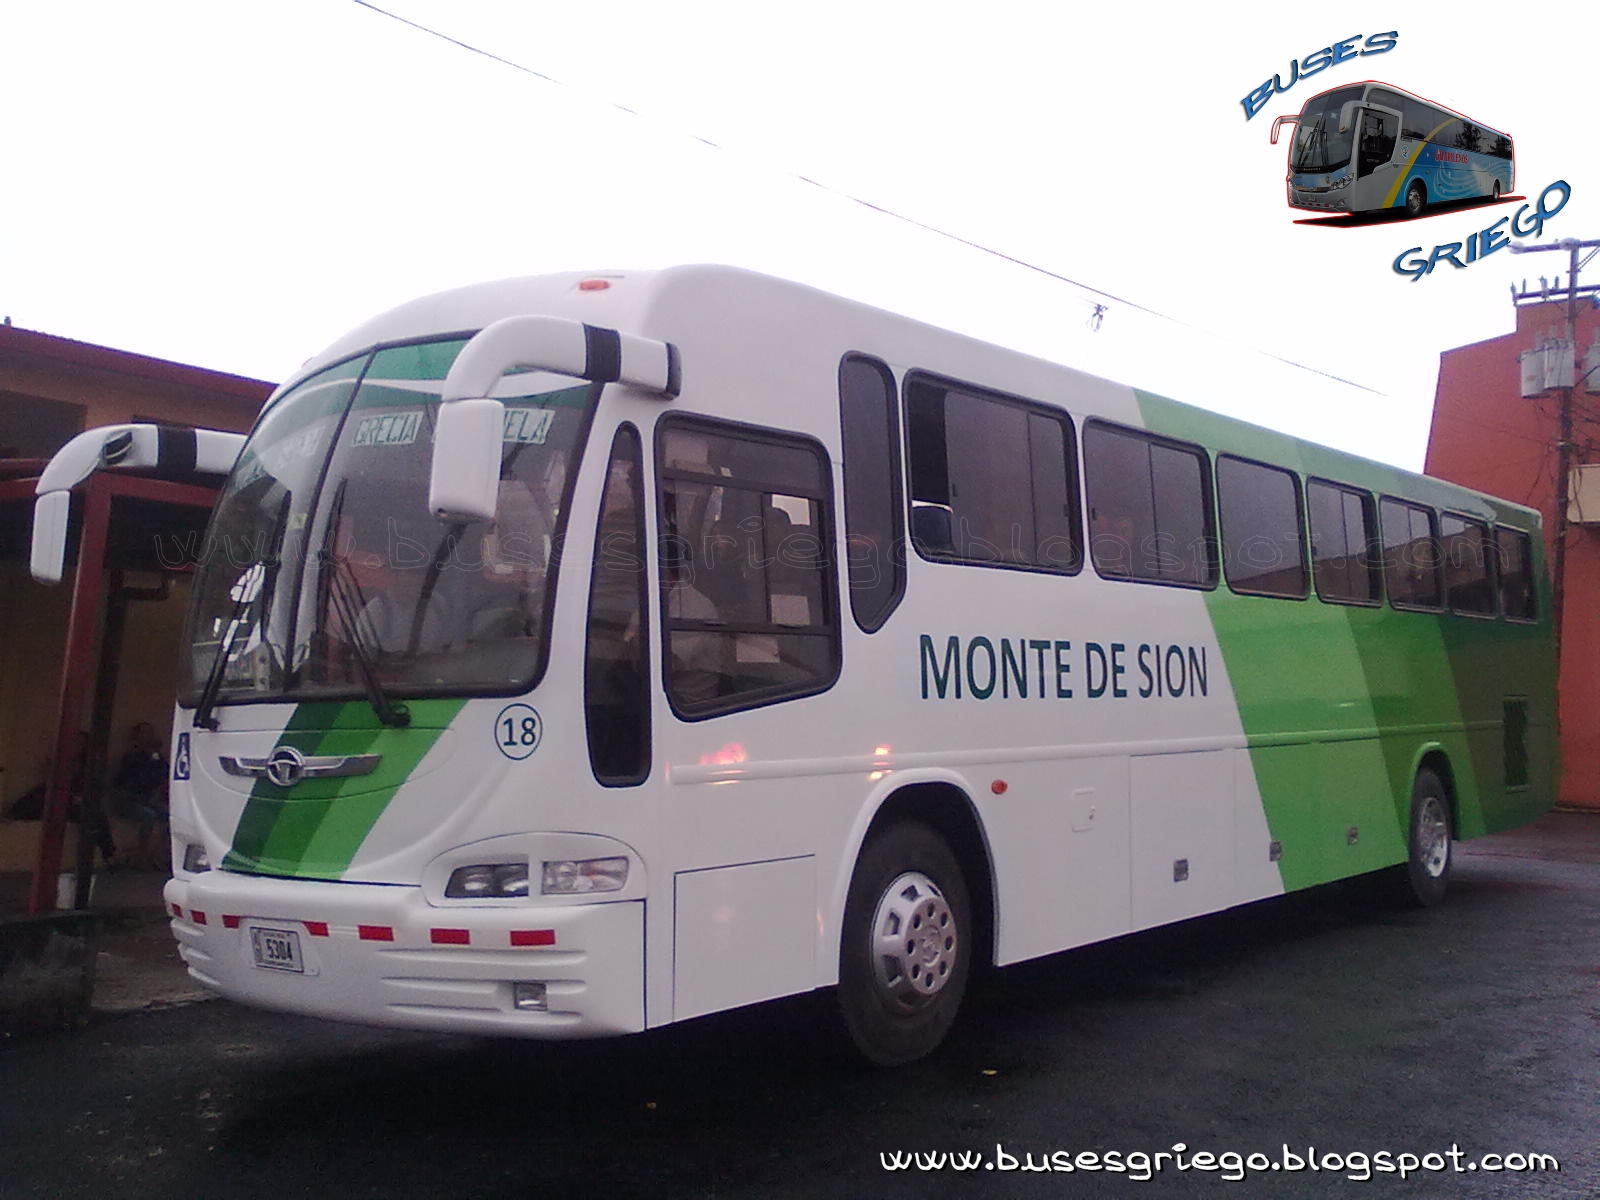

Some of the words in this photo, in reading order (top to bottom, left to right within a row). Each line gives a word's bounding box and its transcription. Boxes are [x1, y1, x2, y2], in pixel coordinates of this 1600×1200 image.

[919, 634, 1073, 700] MONTE
[1085, 642, 1127, 698] DE
[1137, 643, 1208, 698] SION
[502, 716, 536, 746] 18
